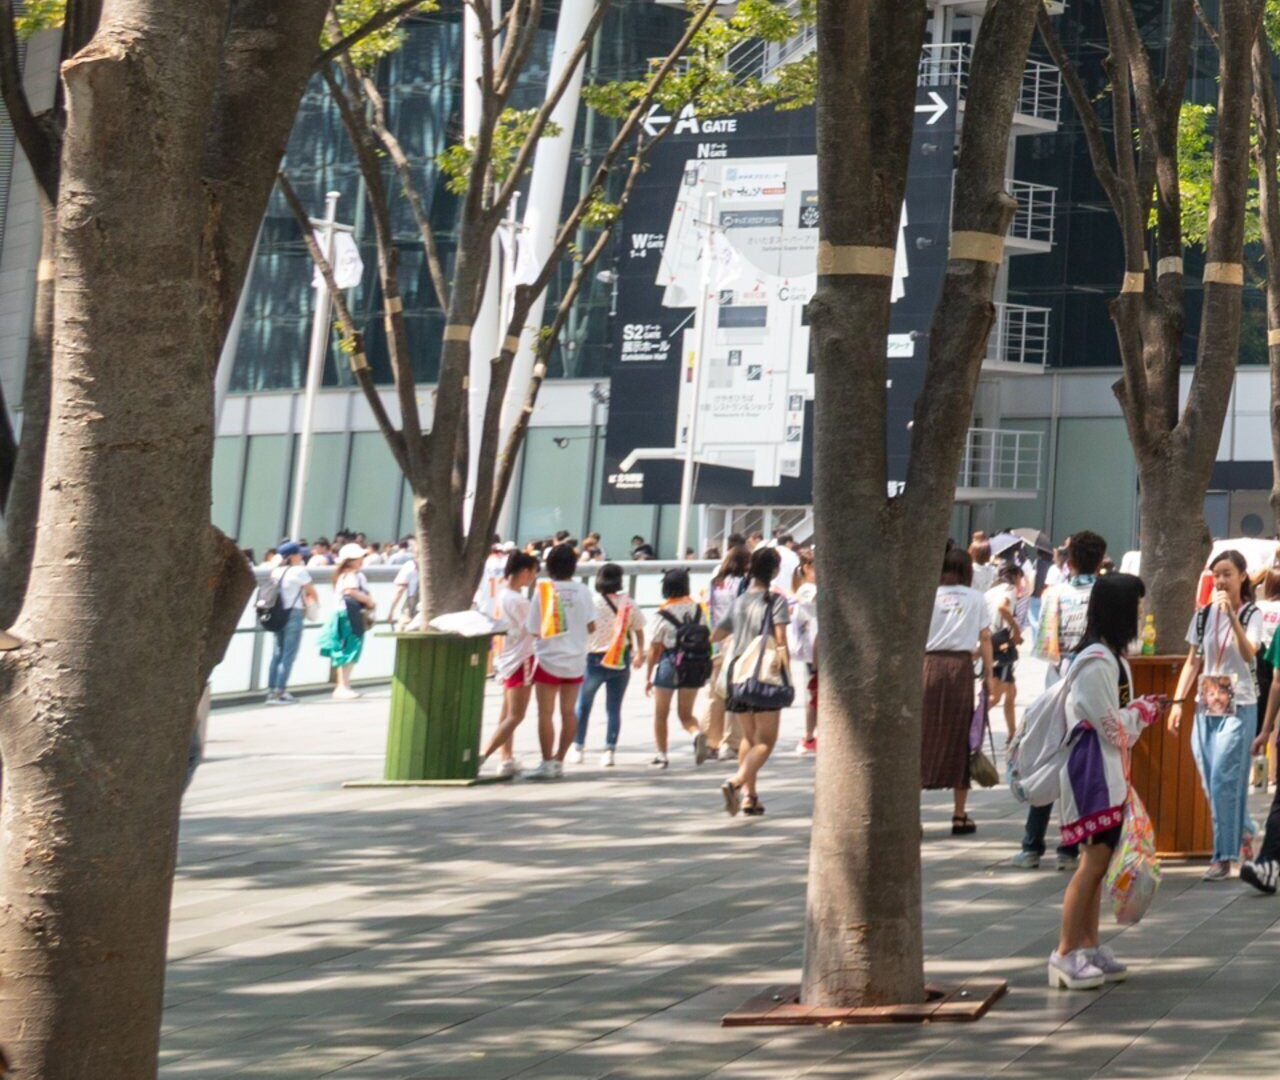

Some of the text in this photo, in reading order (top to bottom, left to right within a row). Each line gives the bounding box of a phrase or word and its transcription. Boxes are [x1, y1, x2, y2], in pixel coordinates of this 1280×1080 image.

[674, 104, 737, 134] A GATE
[698, 144, 710, 157] N
[632, 233, 648, 249] W
[778, 287, 789, 301] C
[623, 324, 644, 340] S2
